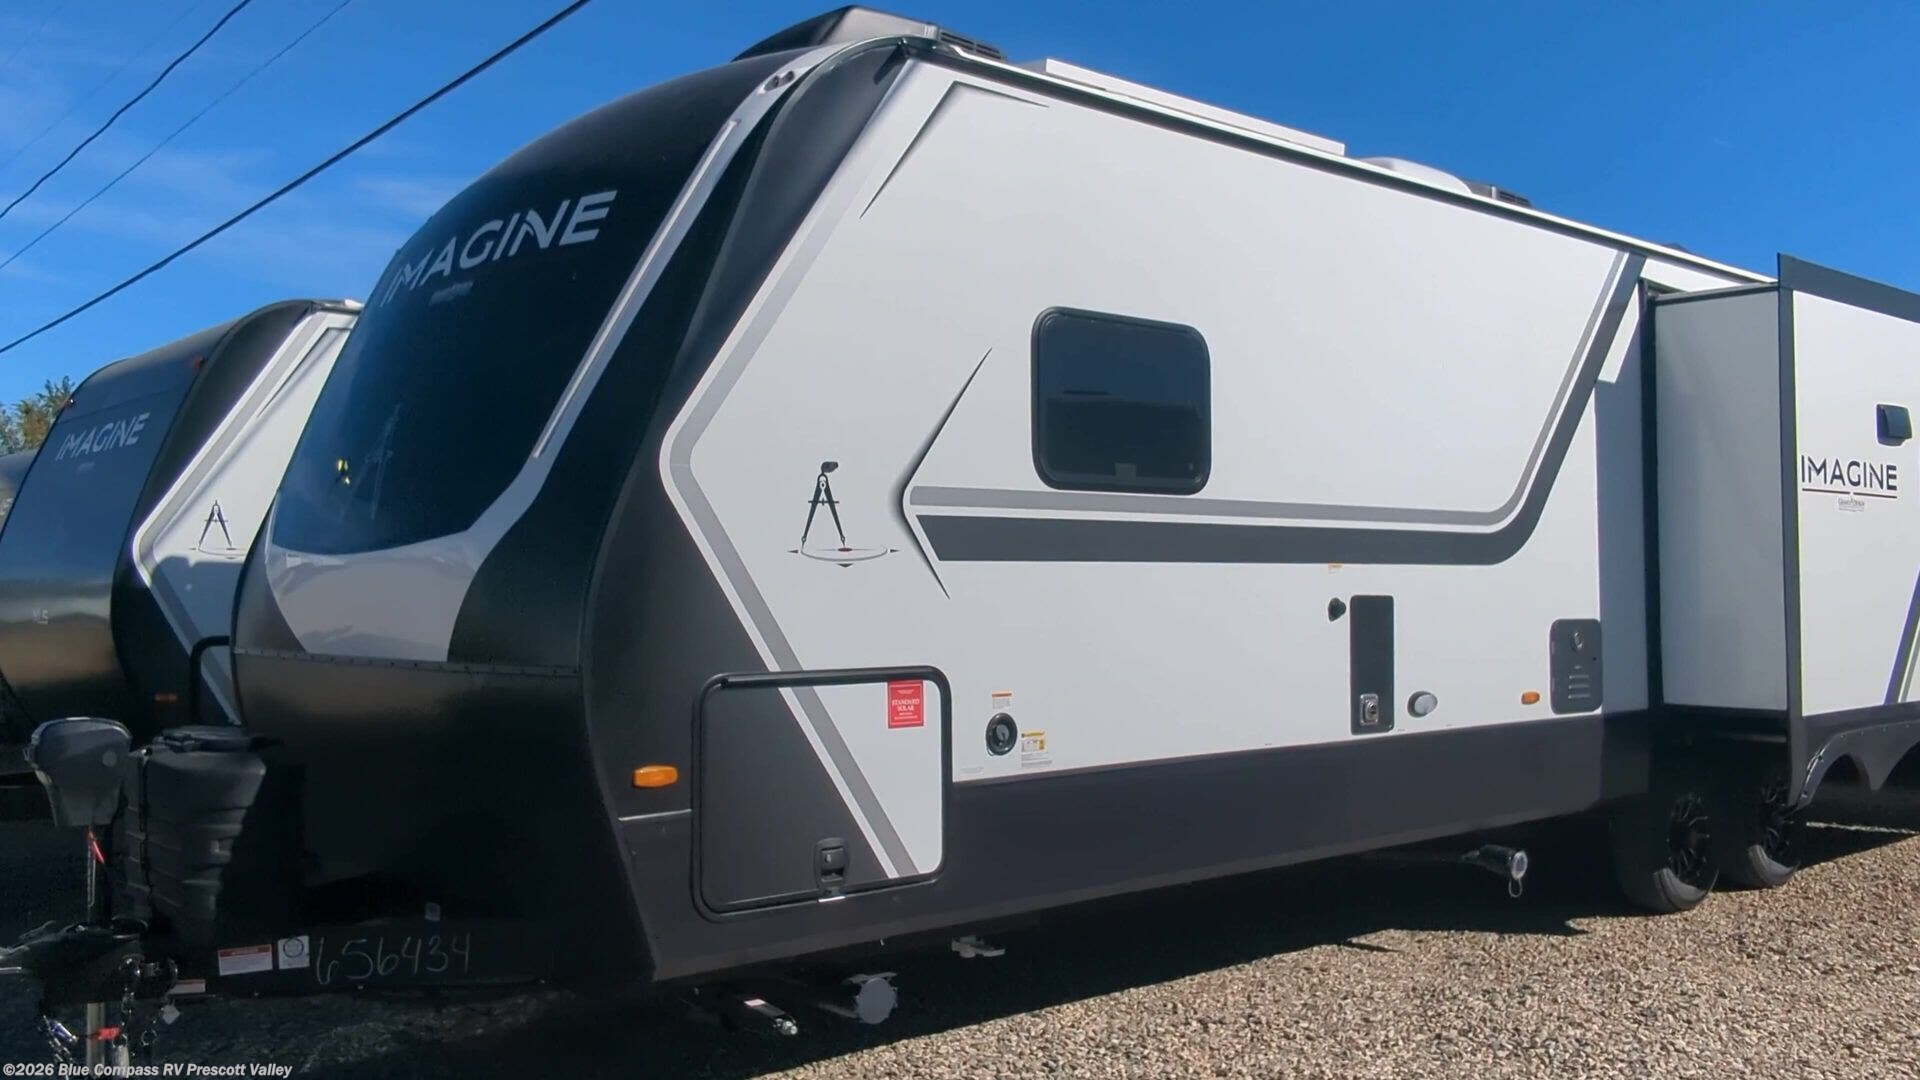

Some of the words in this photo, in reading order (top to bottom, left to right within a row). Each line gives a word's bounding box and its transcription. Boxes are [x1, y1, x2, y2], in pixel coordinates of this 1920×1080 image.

[380, 190, 618, 308] IMAGINE
[55, 412, 150, 462] IMAGINE
[1801, 455, 1898, 491] IMAGINE
[316, 933, 471, 985] 656434
